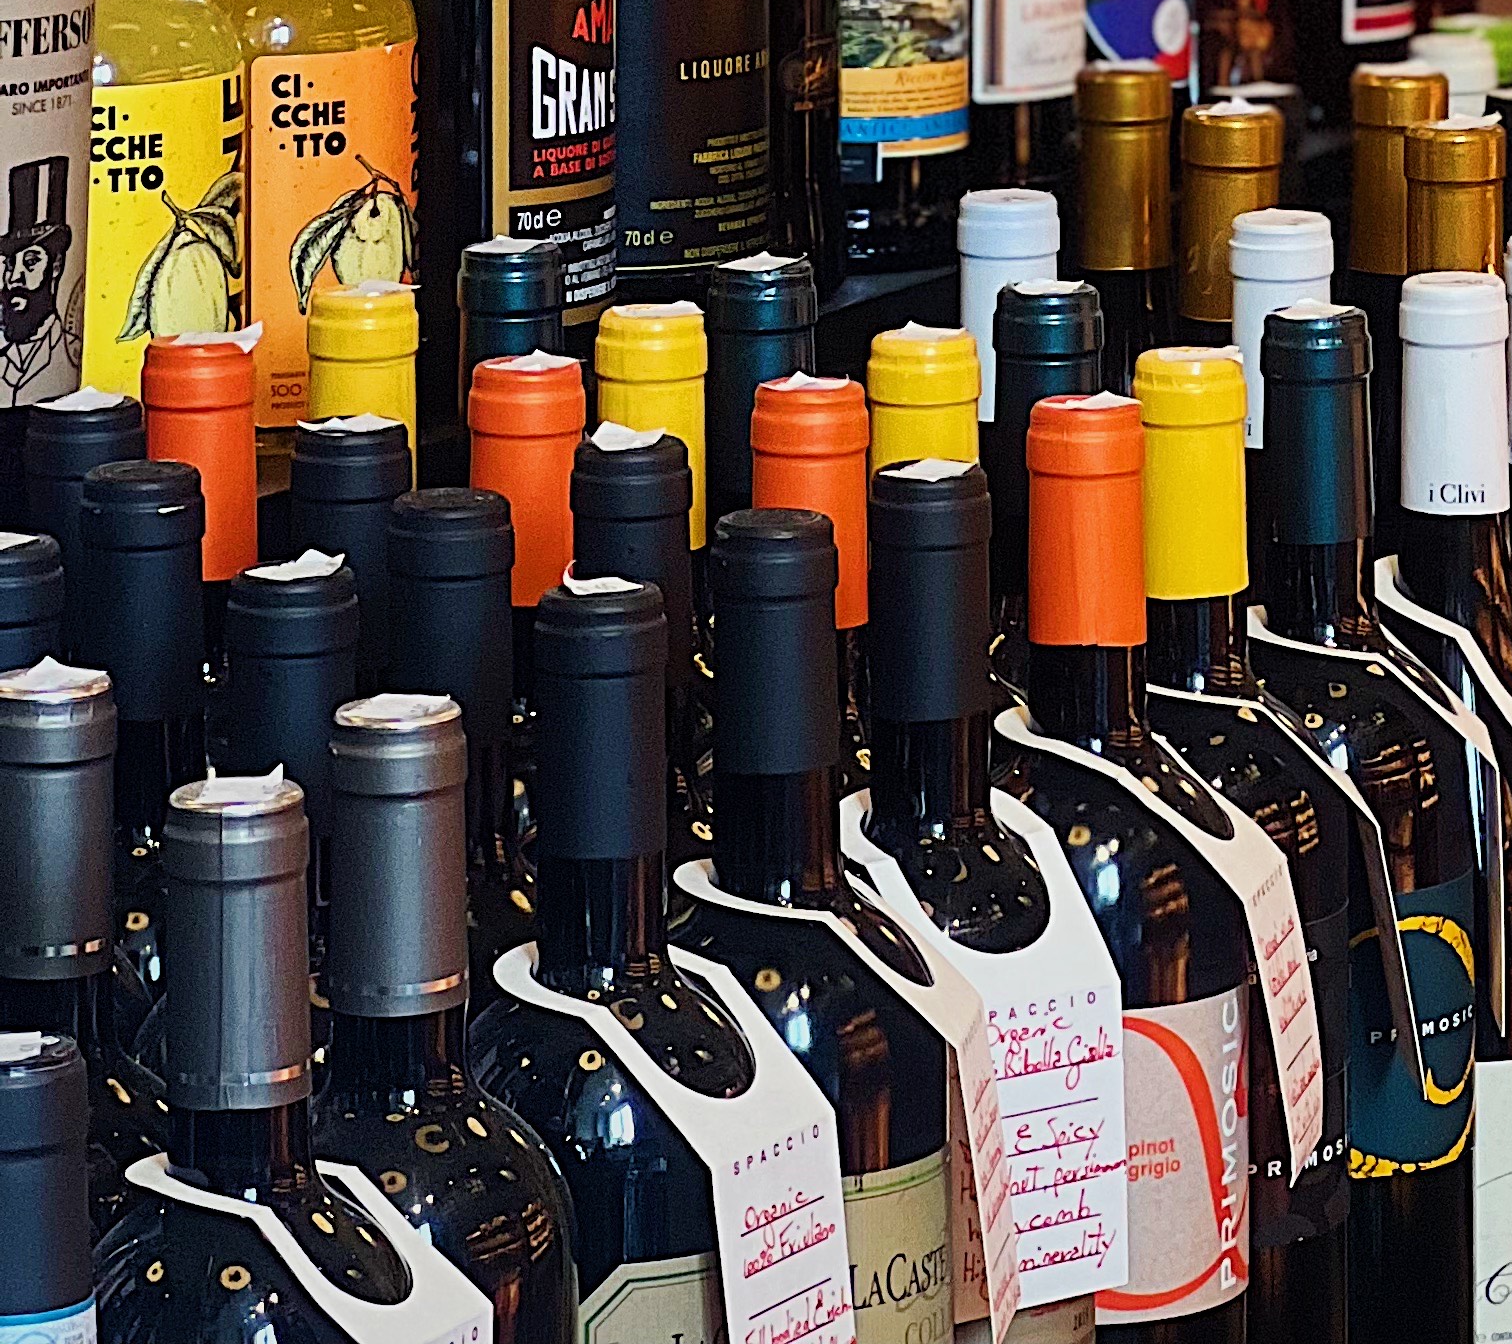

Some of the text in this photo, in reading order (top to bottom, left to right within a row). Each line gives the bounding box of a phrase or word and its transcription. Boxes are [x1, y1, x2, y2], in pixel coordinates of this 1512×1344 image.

[680, 54, 751, 81] LIQUORE
[11, 98, 47, 116] SINCE
[271, 100, 346, 129] CCHE
[90, 133, 164, 162] CCHE
[533, 143, 588, 163] LIQUORE
[550, 160, 582, 177] BASE
[517, 211, 532, 231] 70
[624, 230, 640, 247] 70
[1440, 482, 1486, 504] Clivi
[733, 1123, 821, 1176] SPACCIO
[1128, 1137, 1176, 1159] pinot
[1220, 997, 1239, 1291] PRIMOSIC
[1128, 1157, 1182, 1182] grigio
[744, 1187, 809, 1249] Organic
